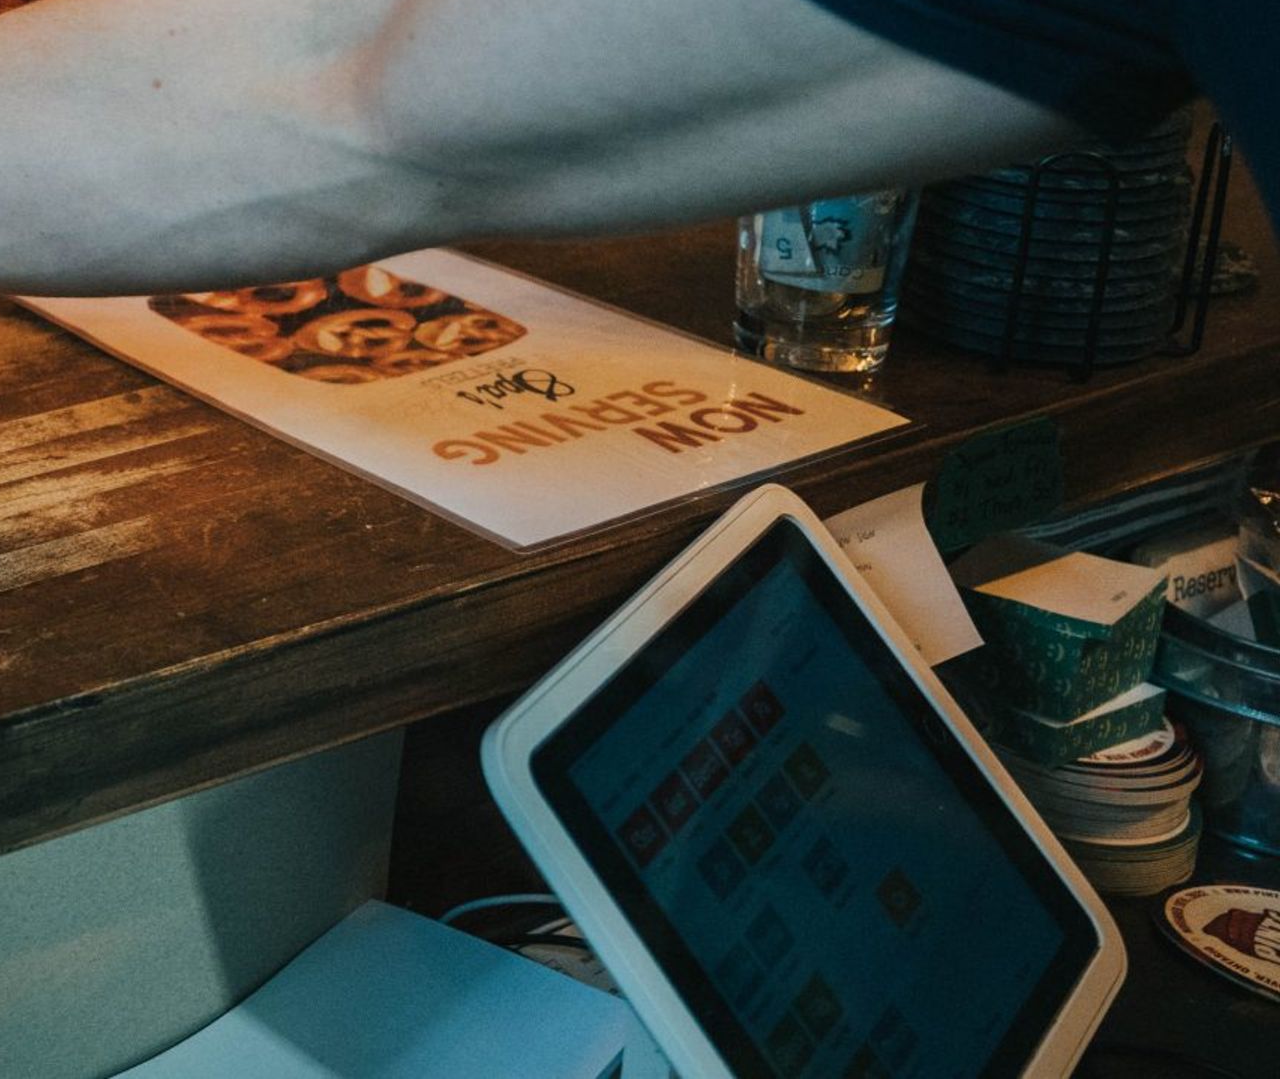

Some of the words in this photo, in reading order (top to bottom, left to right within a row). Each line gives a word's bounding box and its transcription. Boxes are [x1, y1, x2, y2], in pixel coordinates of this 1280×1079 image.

[776, 237, 793, 260] 5
[431, 380, 707, 466] SERVING
[632, 391, 805, 454] NOW
